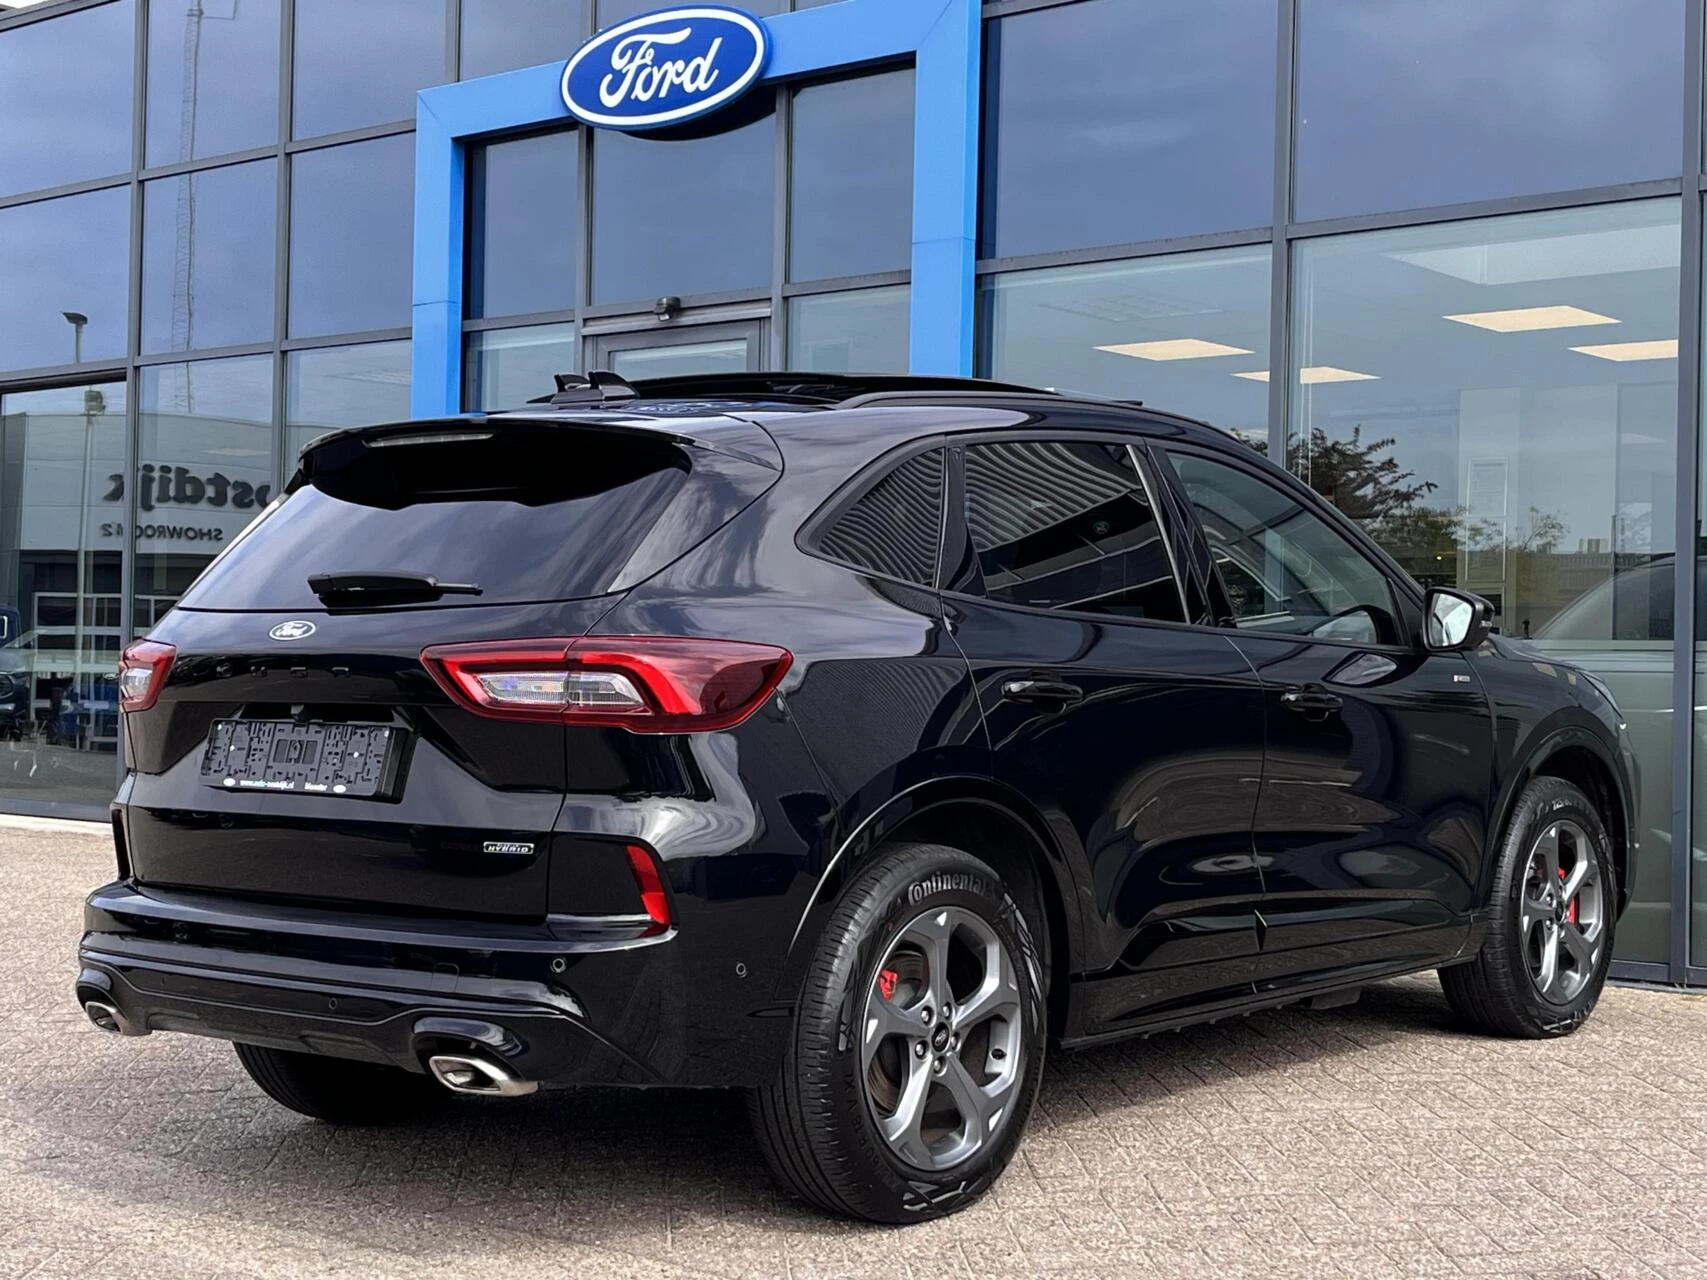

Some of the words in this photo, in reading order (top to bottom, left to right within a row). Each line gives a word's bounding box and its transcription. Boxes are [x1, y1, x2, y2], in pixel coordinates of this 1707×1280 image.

[599, 26, 723, 108] Ford
[487, 845, 529, 853] HYBRID
[907, 871, 986, 907] Continental
